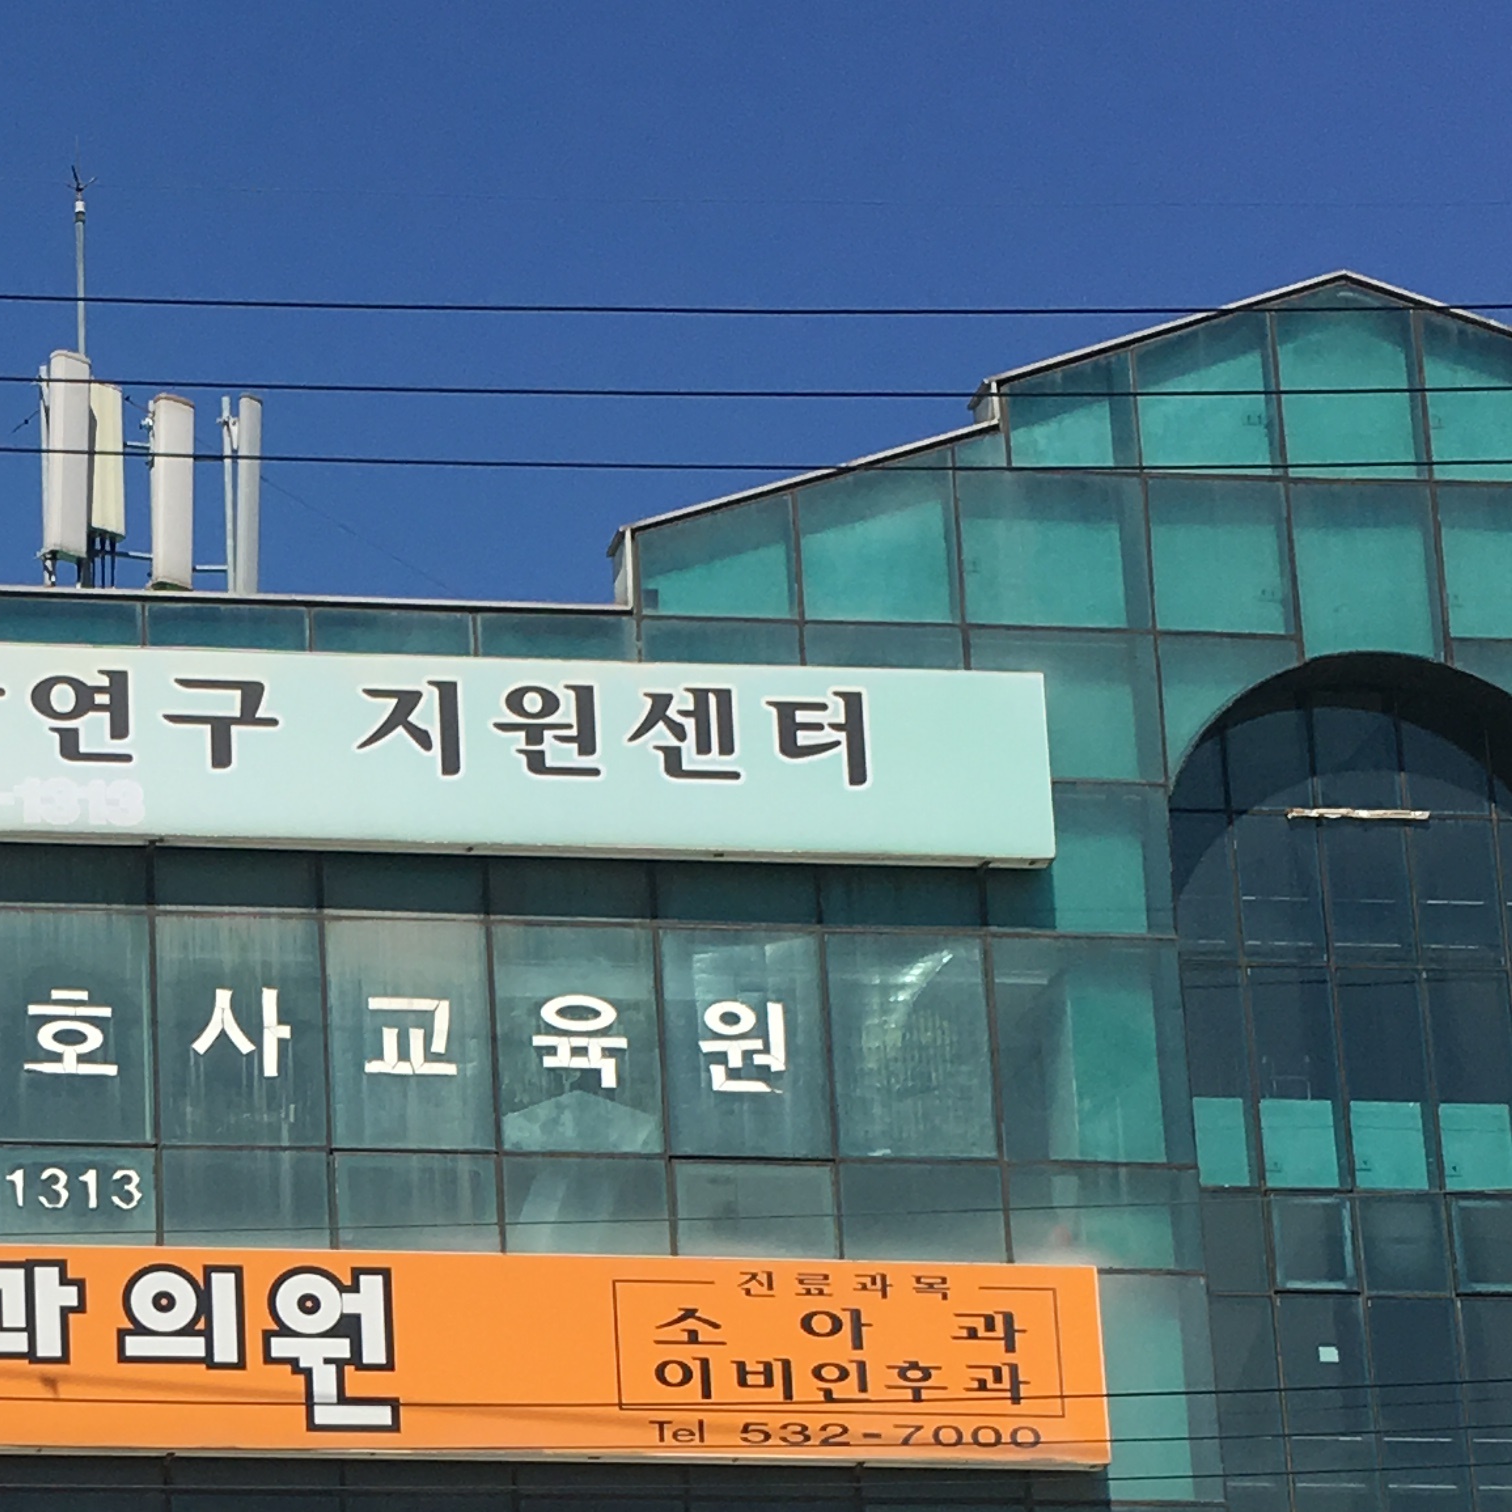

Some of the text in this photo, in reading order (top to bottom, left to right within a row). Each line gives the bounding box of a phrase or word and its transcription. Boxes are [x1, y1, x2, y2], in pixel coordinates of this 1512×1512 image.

[356, 678, 871, 788] 지원센터
[737, 1269, 952, 1301] 진료과목
[654, 1307, 1028, 1354] 소아과
[654, 1357, 1032, 1406] 이비인후과
[649, 1420, 1042, 1449] Tel 532-7000
